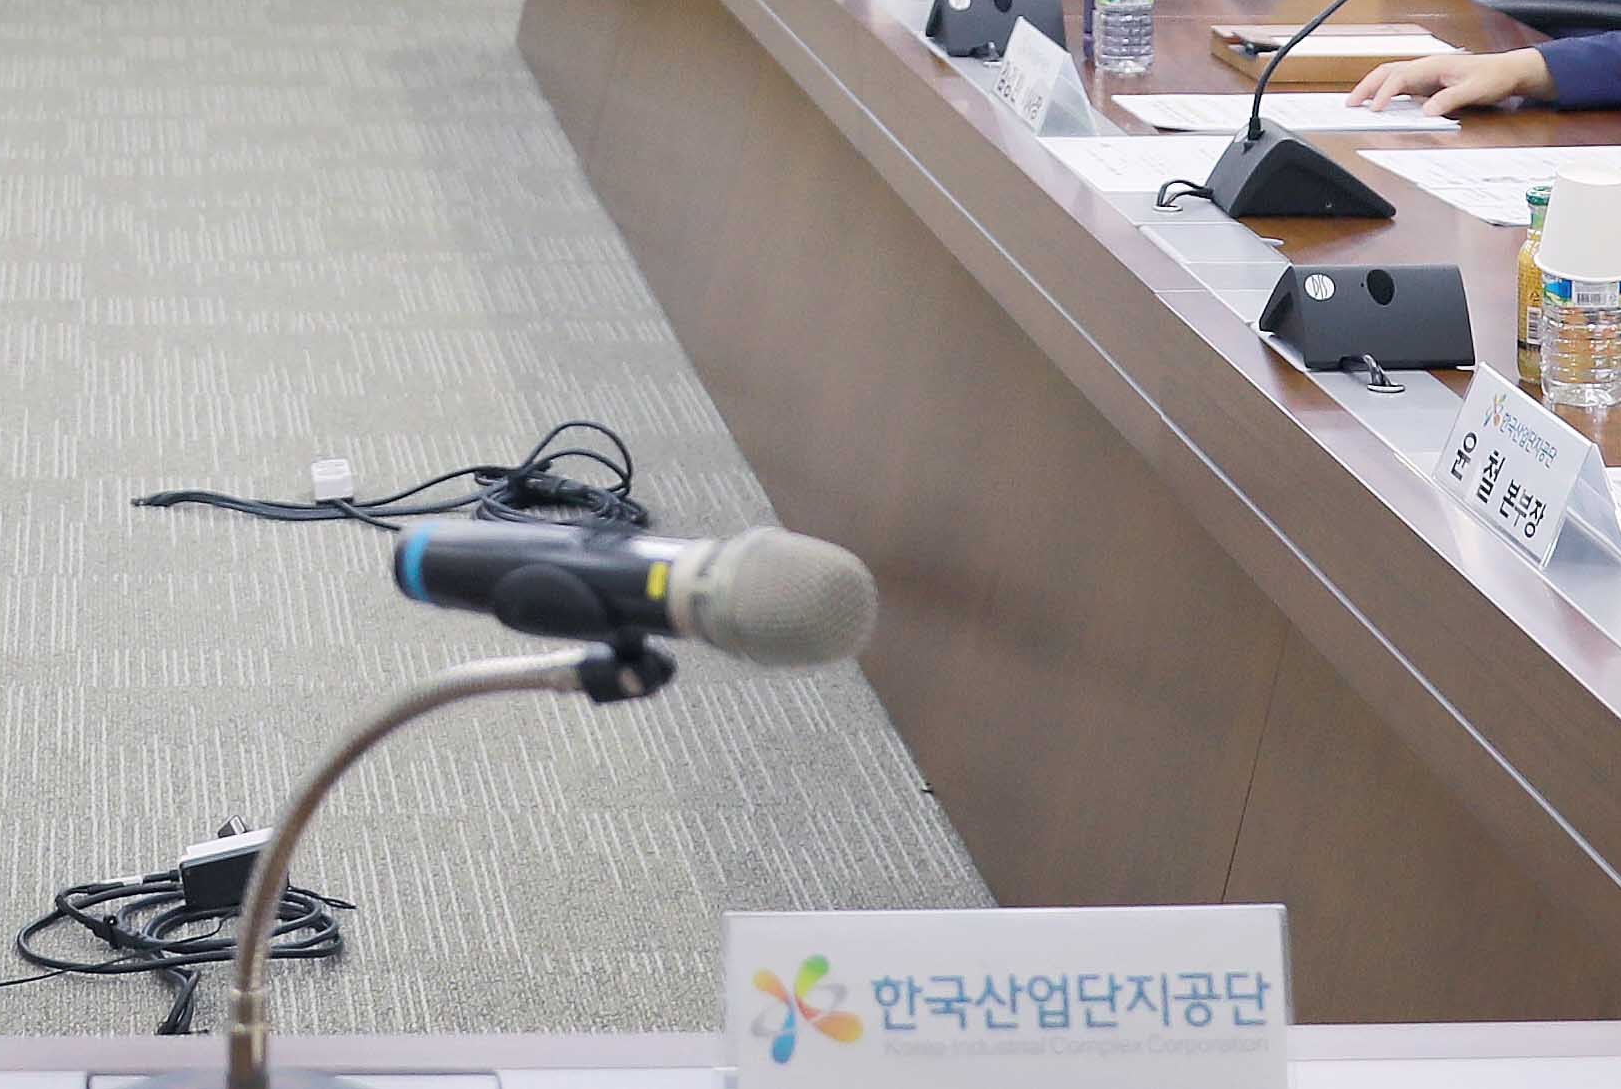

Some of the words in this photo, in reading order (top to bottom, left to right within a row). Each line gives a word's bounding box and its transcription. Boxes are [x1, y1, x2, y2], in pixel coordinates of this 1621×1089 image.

[1450, 431, 1478, 482] 윤
[1475, 449, 1507, 504] 철
[1499, 478, 1548, 539] 본부장
[870, 971, 1272, 1032] 한국산업단지공단
